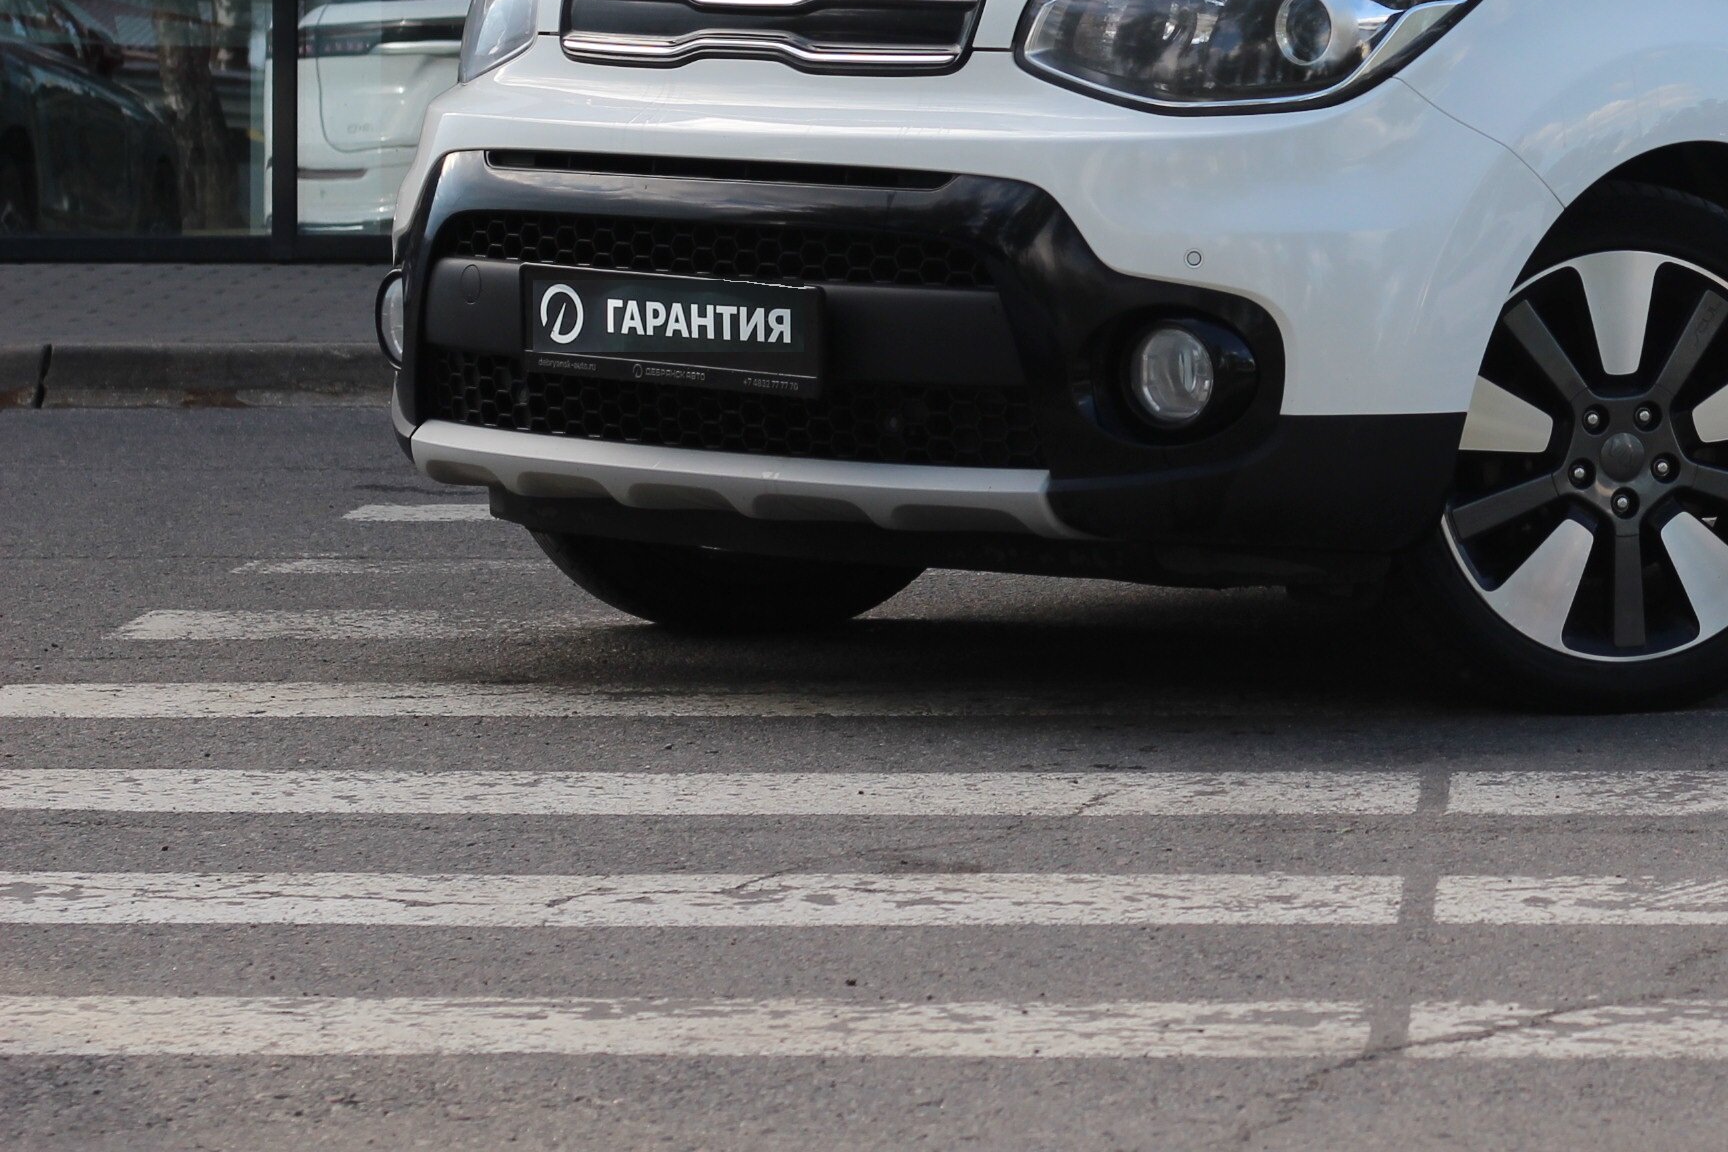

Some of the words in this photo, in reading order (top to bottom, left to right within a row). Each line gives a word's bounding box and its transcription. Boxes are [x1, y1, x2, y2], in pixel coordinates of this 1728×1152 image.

[606, 298, 792, 344] ГАРАНТИЯ
[645, 367, 685, 379] ДЕБРЯНСК
[686, 371, 706, 381] АВТО
